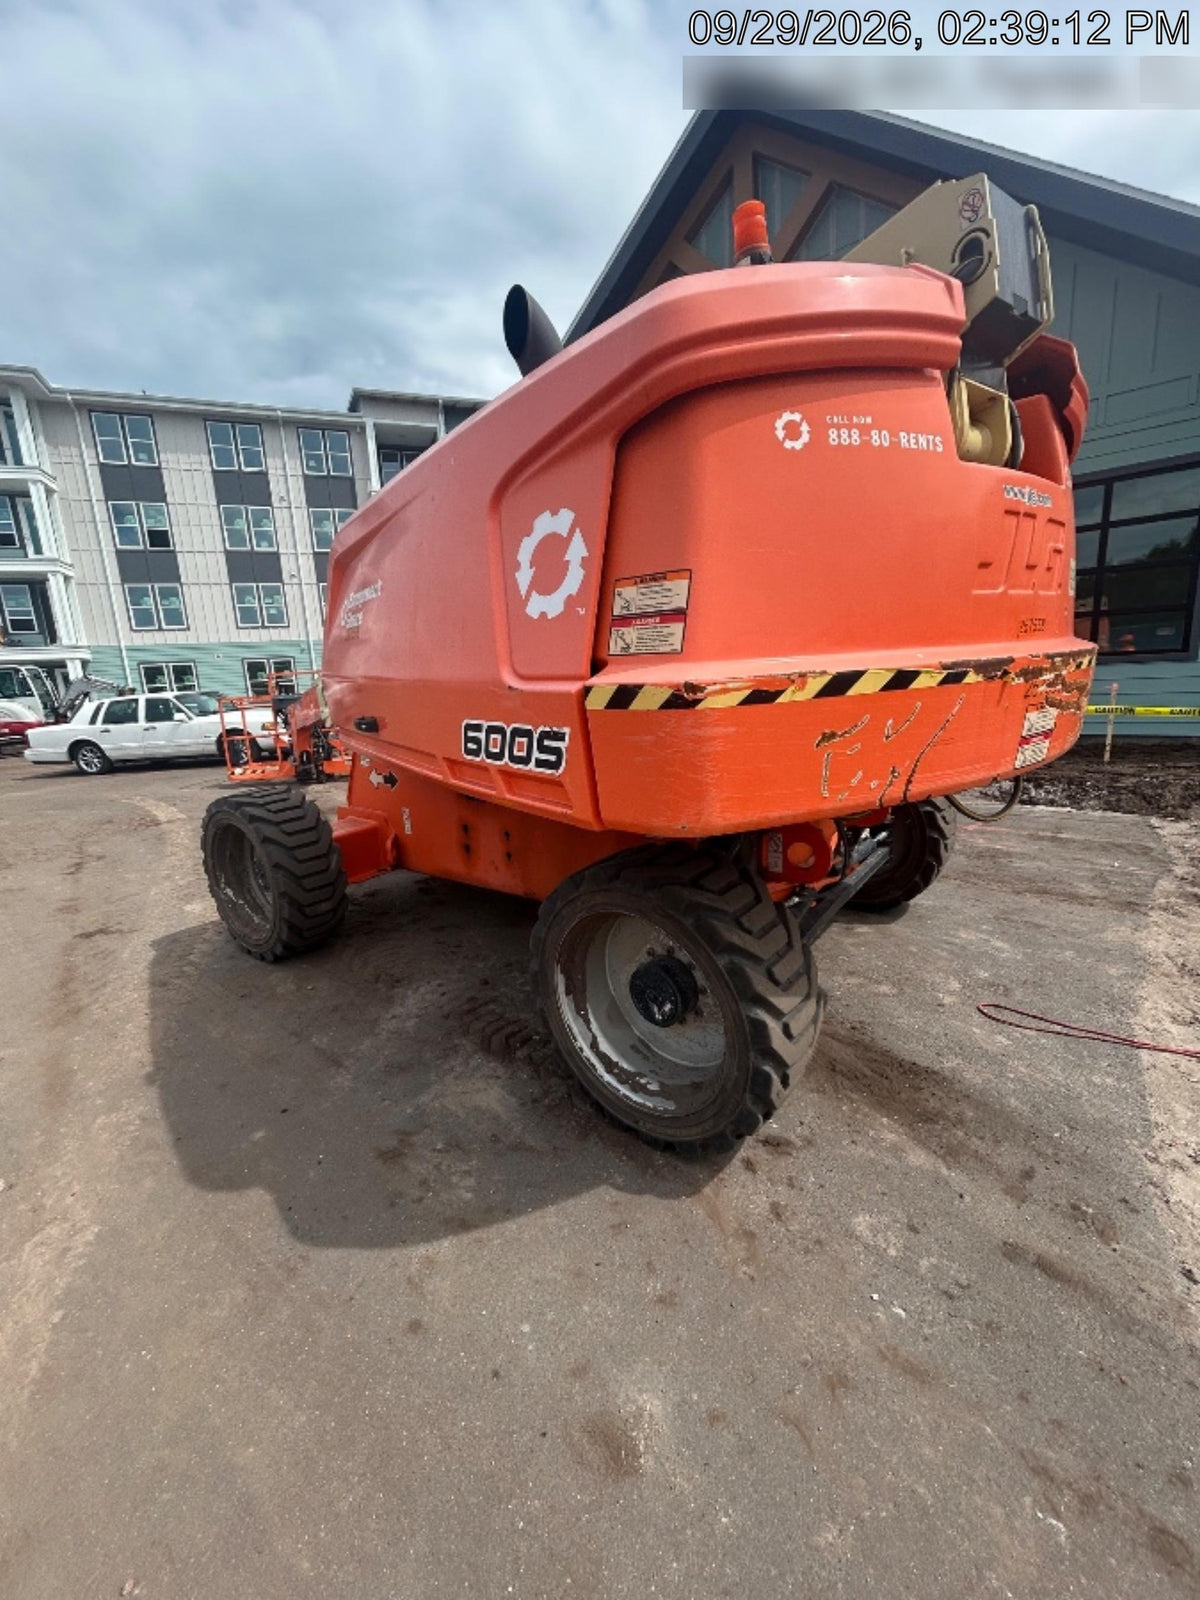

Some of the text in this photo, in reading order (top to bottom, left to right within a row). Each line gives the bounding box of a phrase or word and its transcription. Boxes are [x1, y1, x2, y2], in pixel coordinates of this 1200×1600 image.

[826, 415, 849, 424] CALL
[828, 427, 944, 453] 888-80-RENTS
[462, 719, 571, 776] 600S
